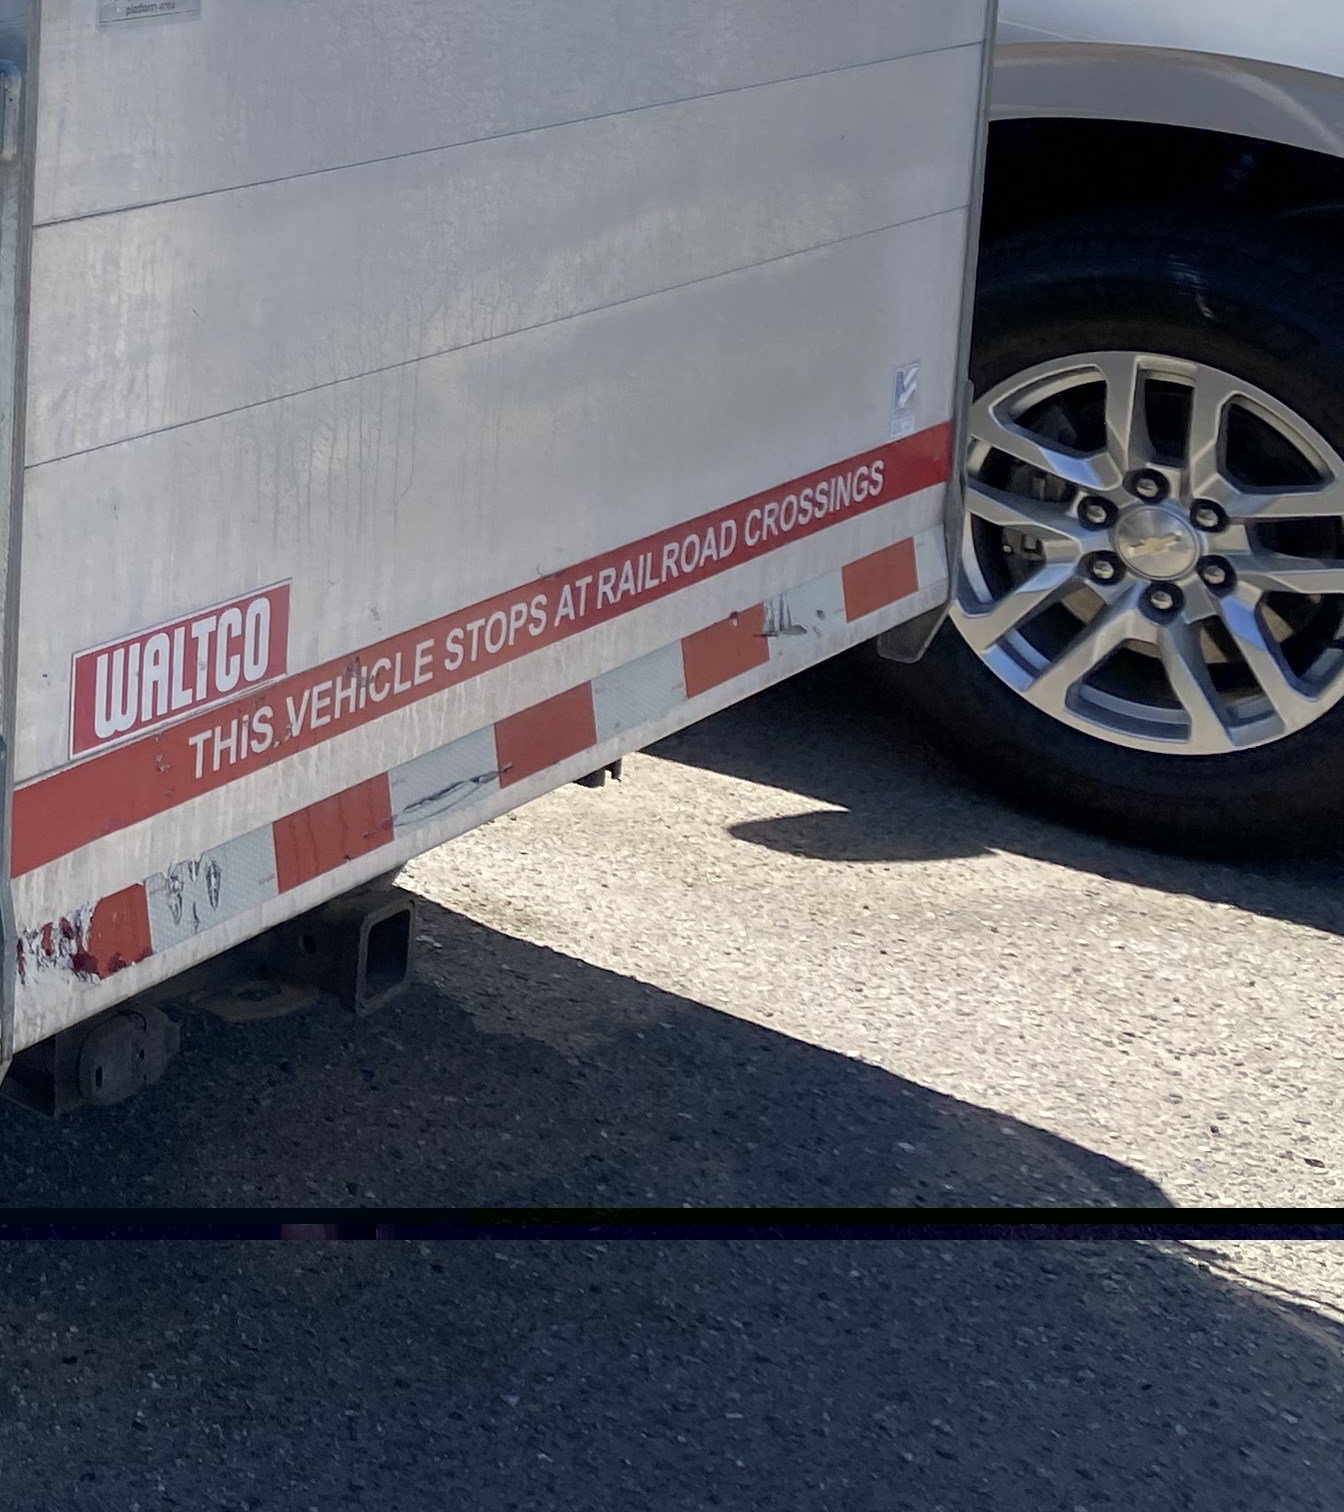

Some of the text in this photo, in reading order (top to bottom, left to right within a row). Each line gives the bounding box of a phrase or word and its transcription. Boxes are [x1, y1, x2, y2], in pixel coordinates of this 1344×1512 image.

[94, 596, 271, 739] WALTCO
[188, 459, 885, 779] THIS VEHICLE STOPS AT RAILROAD CROSSINGS
